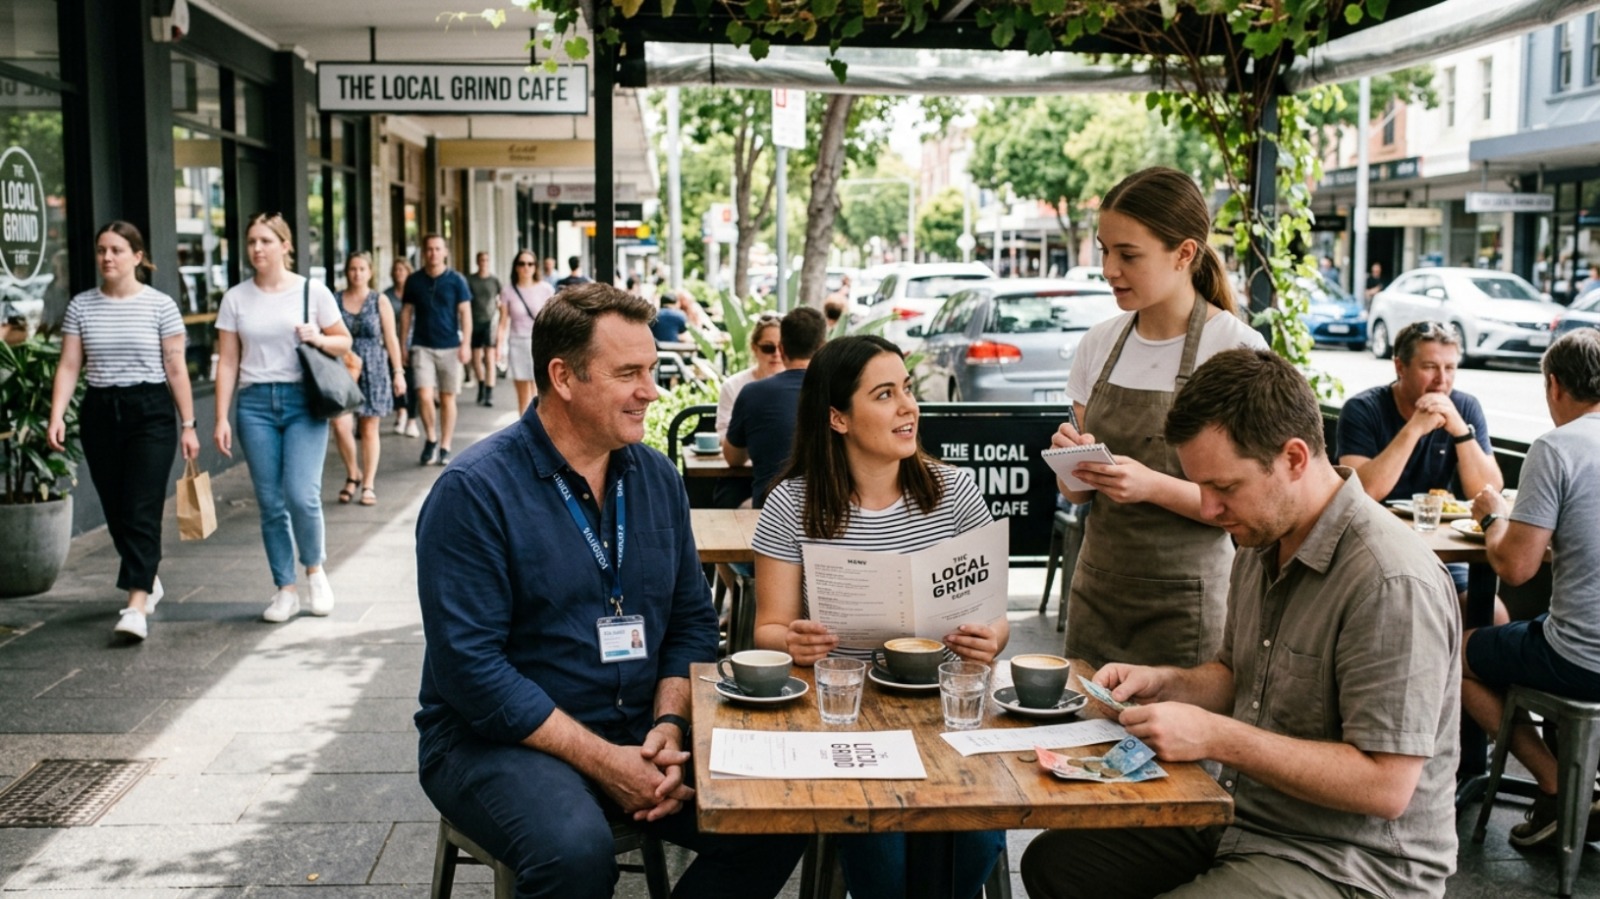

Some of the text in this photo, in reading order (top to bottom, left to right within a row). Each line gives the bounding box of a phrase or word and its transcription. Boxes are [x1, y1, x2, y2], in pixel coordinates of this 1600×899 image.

[337, 75, 568, 101] THE LOCAL GRIND CAFE
[1, 180, 38, 211] LOCAL
[3, 212, 38, 243] GRIND
[941, 443, 1029, 461] THE LOCAL
[957, 467, 1029, 495] IND
[991, 501, 1029, 516] CAFE
[931, 555, 989, 585] LOCAL
[932, 568, 989, 598] GRIND
[1119, 739, 1136, 753] 10
